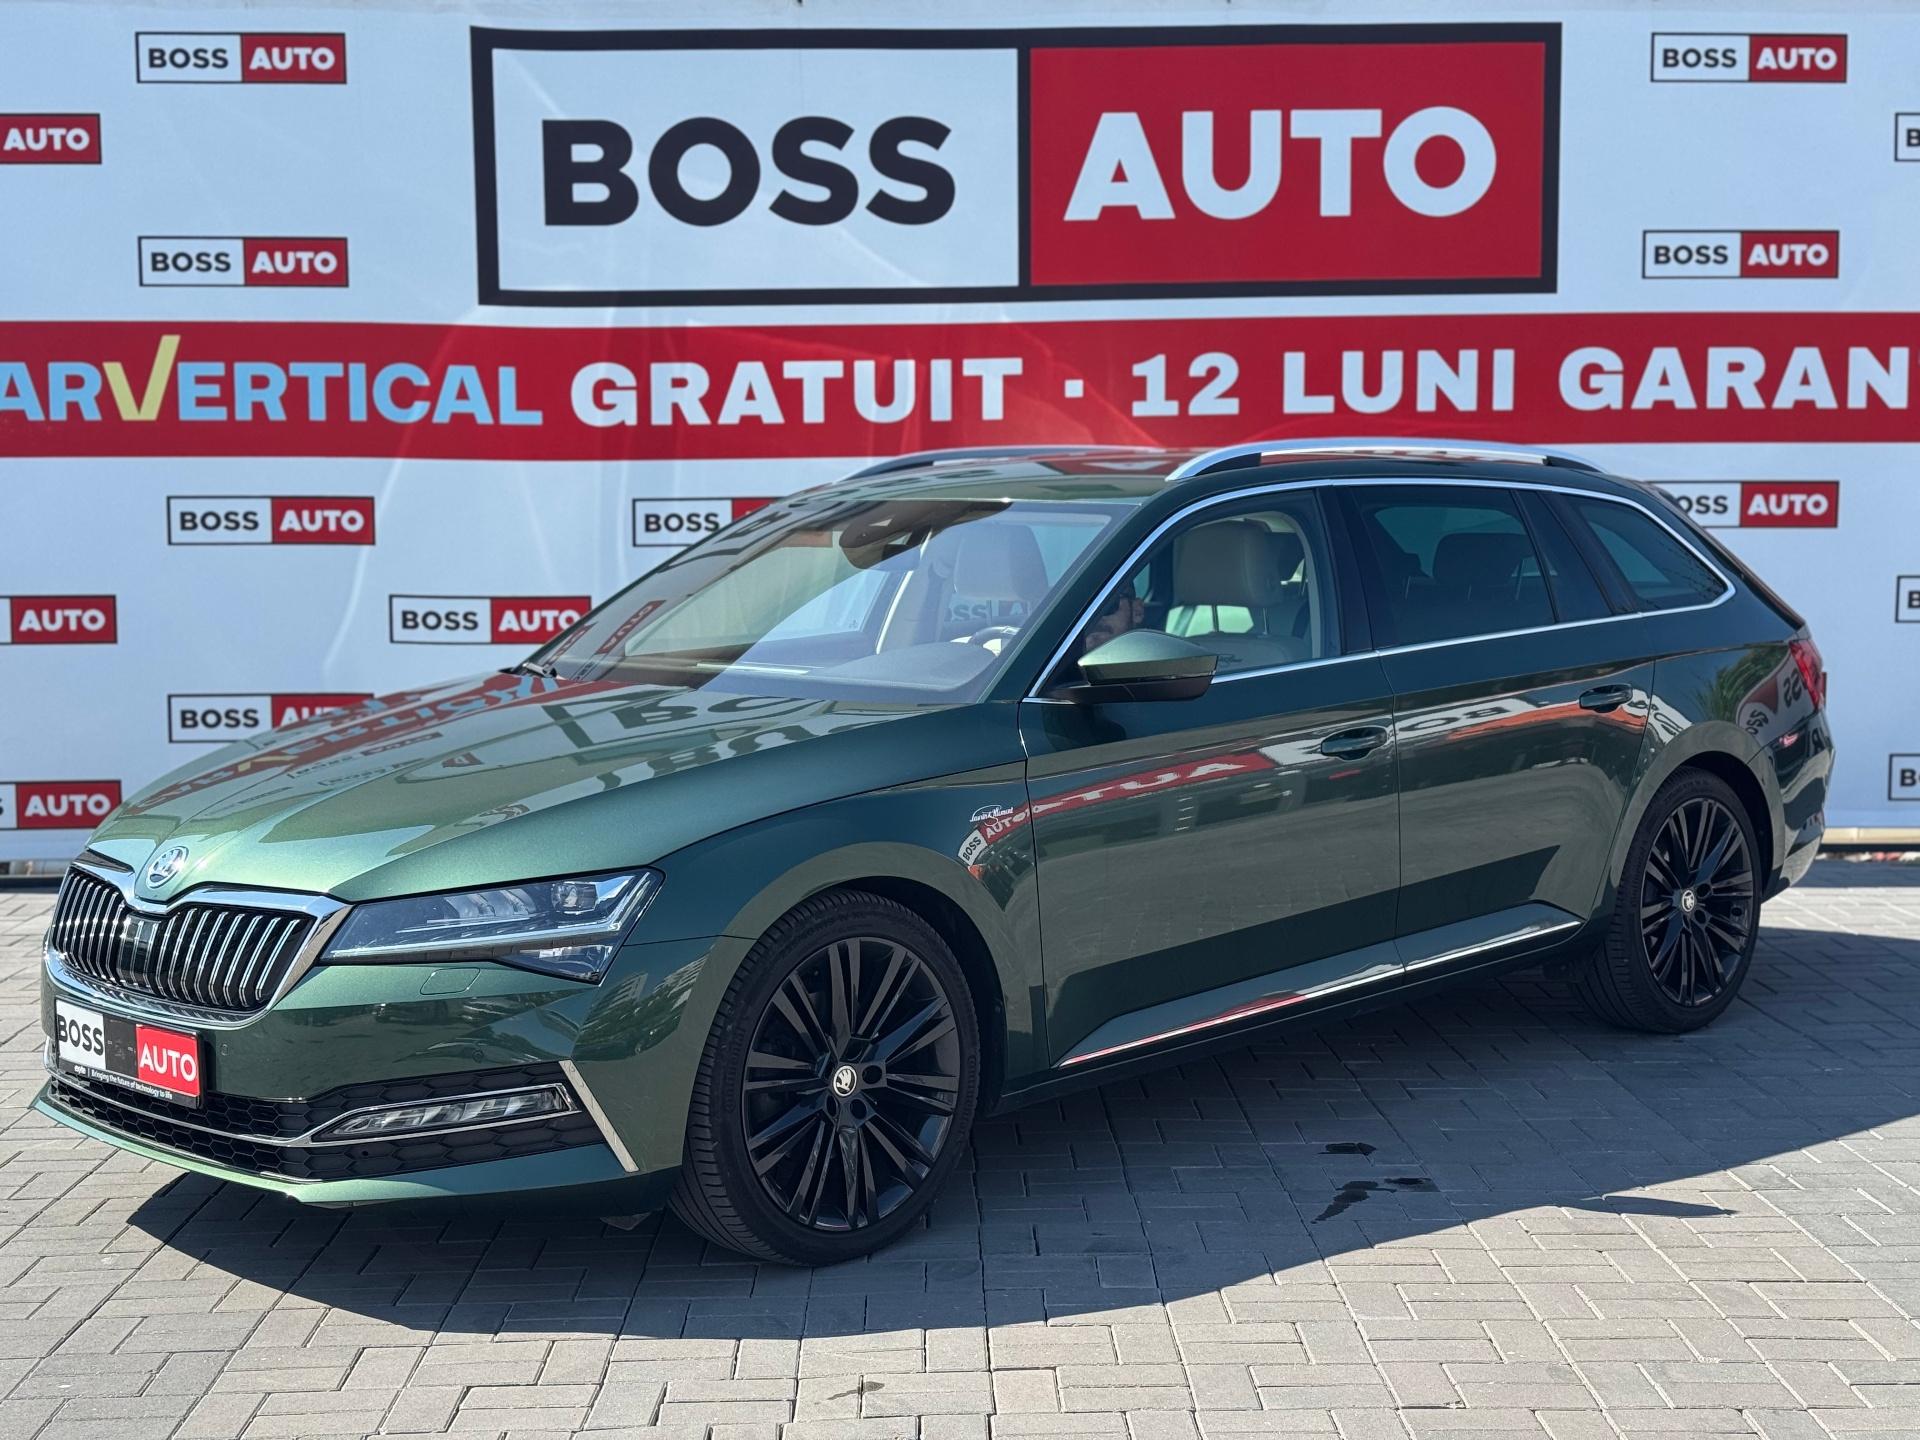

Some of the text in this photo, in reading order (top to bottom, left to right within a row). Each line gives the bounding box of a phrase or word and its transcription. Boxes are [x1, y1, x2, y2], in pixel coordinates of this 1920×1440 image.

[148, 47, 336, 71] BOSS AUTO
[1662, 47, 1838, 71] BOSS AUTO
[3, 127, 90, 151] AUTO
[541, 106, 1497, 227] BOSS AUTO
[150, 251, 338, 273] BOSS AUTO
[1653, 243, 1829, 266] BOSS AUTO
[570, 357, 1023, 428] GRATUIT
[1131, 352, 1240, 417] 12
[1283, 349, 1515, 414] LUNI
[1558, 346, 1920, 411] GARAN
[1676, 493, 1829, 516] OSS AUTO
[179, 509, 365, 533] BOSS AUTO
[644, 512, 719, 532] BOSS
[19, 608, 106, 632] AUTO
[401, 610, 479, 631] BOSS
[498, 609, 581, 632] AUTO
[180, 708, 260, 729] BOSS
[24, 793, 112, 817] AUTO
[56, 1013, 104, 1057] BOSS
[138, 1042, 198, 1082] AUTO
